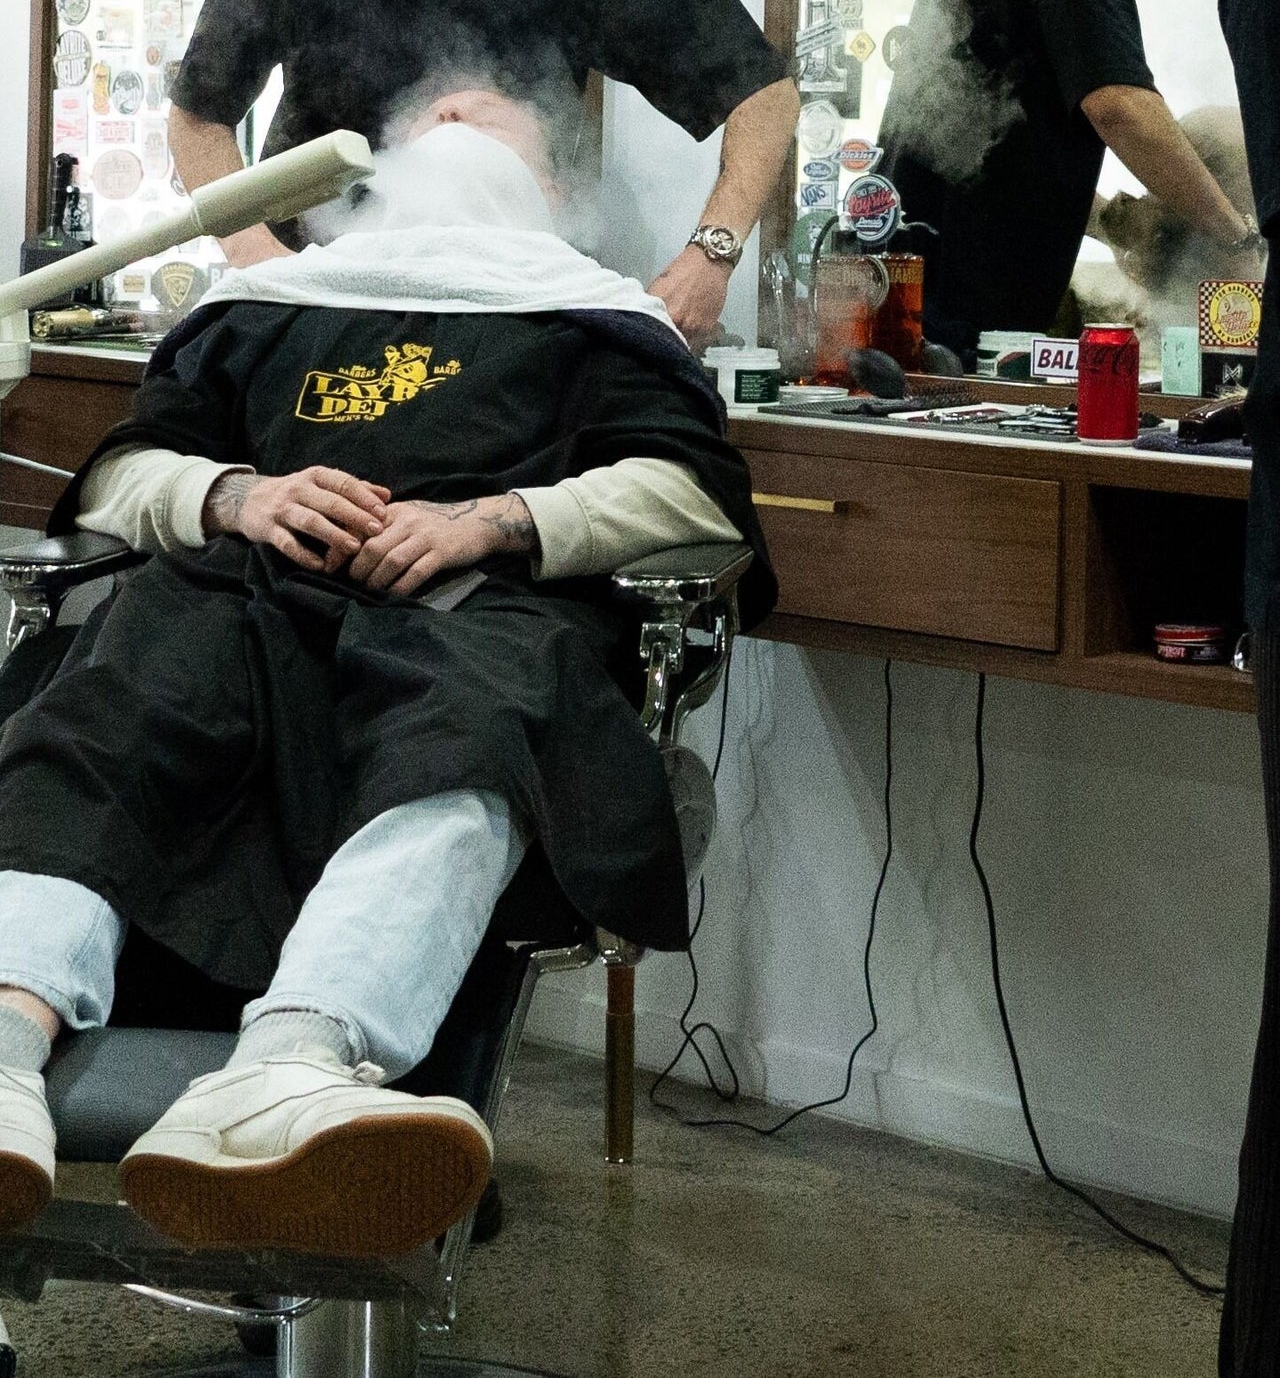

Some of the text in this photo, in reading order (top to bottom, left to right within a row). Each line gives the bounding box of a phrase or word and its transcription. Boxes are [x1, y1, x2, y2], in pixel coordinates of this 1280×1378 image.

[802, 184, 825, 207] VANS
[1038, 349, 1078, 369] BAL
[339, 368, 376, 379] BARBERS
[313, 375, 419, 402] LAYR
